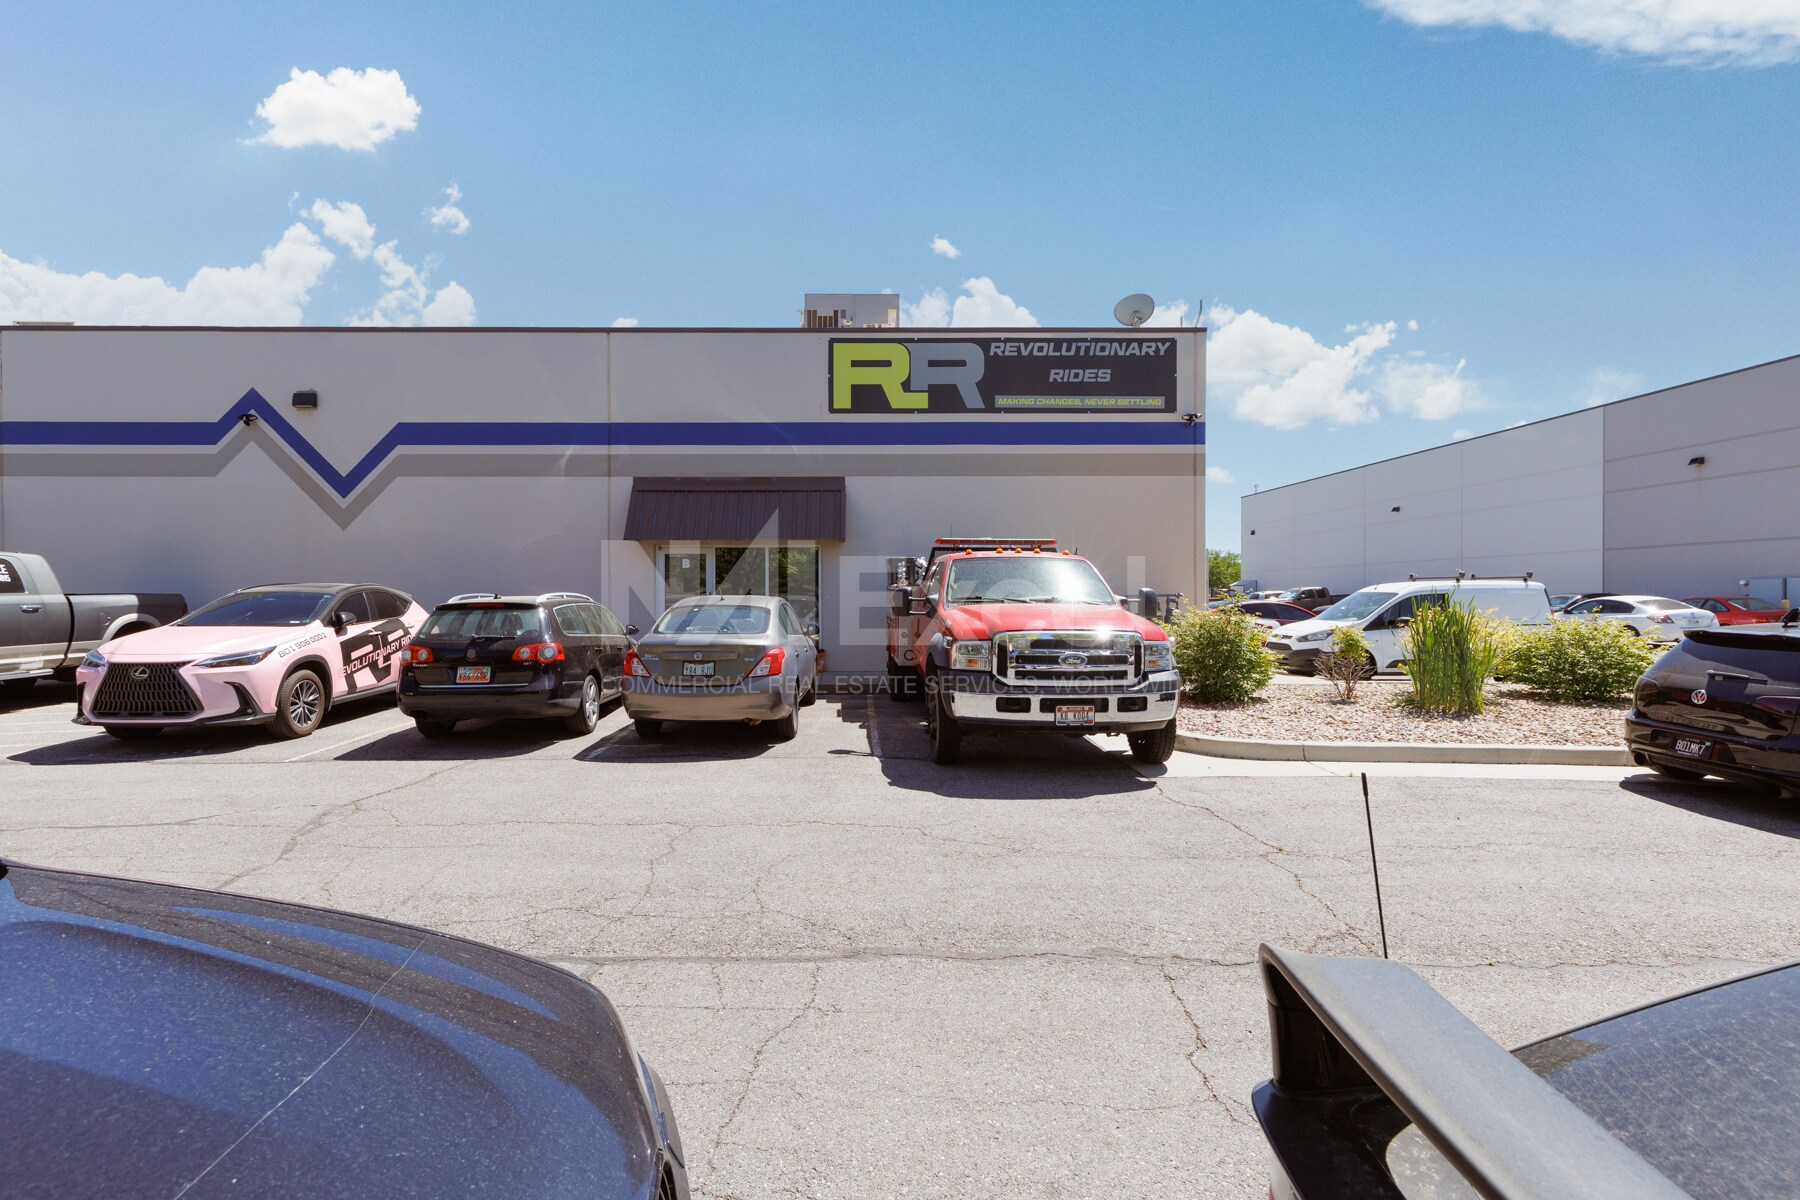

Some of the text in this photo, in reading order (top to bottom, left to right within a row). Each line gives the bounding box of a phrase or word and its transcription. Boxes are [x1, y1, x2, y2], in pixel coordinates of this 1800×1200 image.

[989, 342, 1171, 356] REVOLUTIONARY
[1049, 368, 1111, 383] RIDES
[998, 398, 1161, 407] MAKING CHANGES, NEVER SETTLING
[681, 558, 691, 569] B
[278, 645, 295, 658] 801
[310, 632, 328, 644] 0001
[338, 641, 401, 679] REVOLUTIONARY
[1065, 657, 1082, 665] Ford
